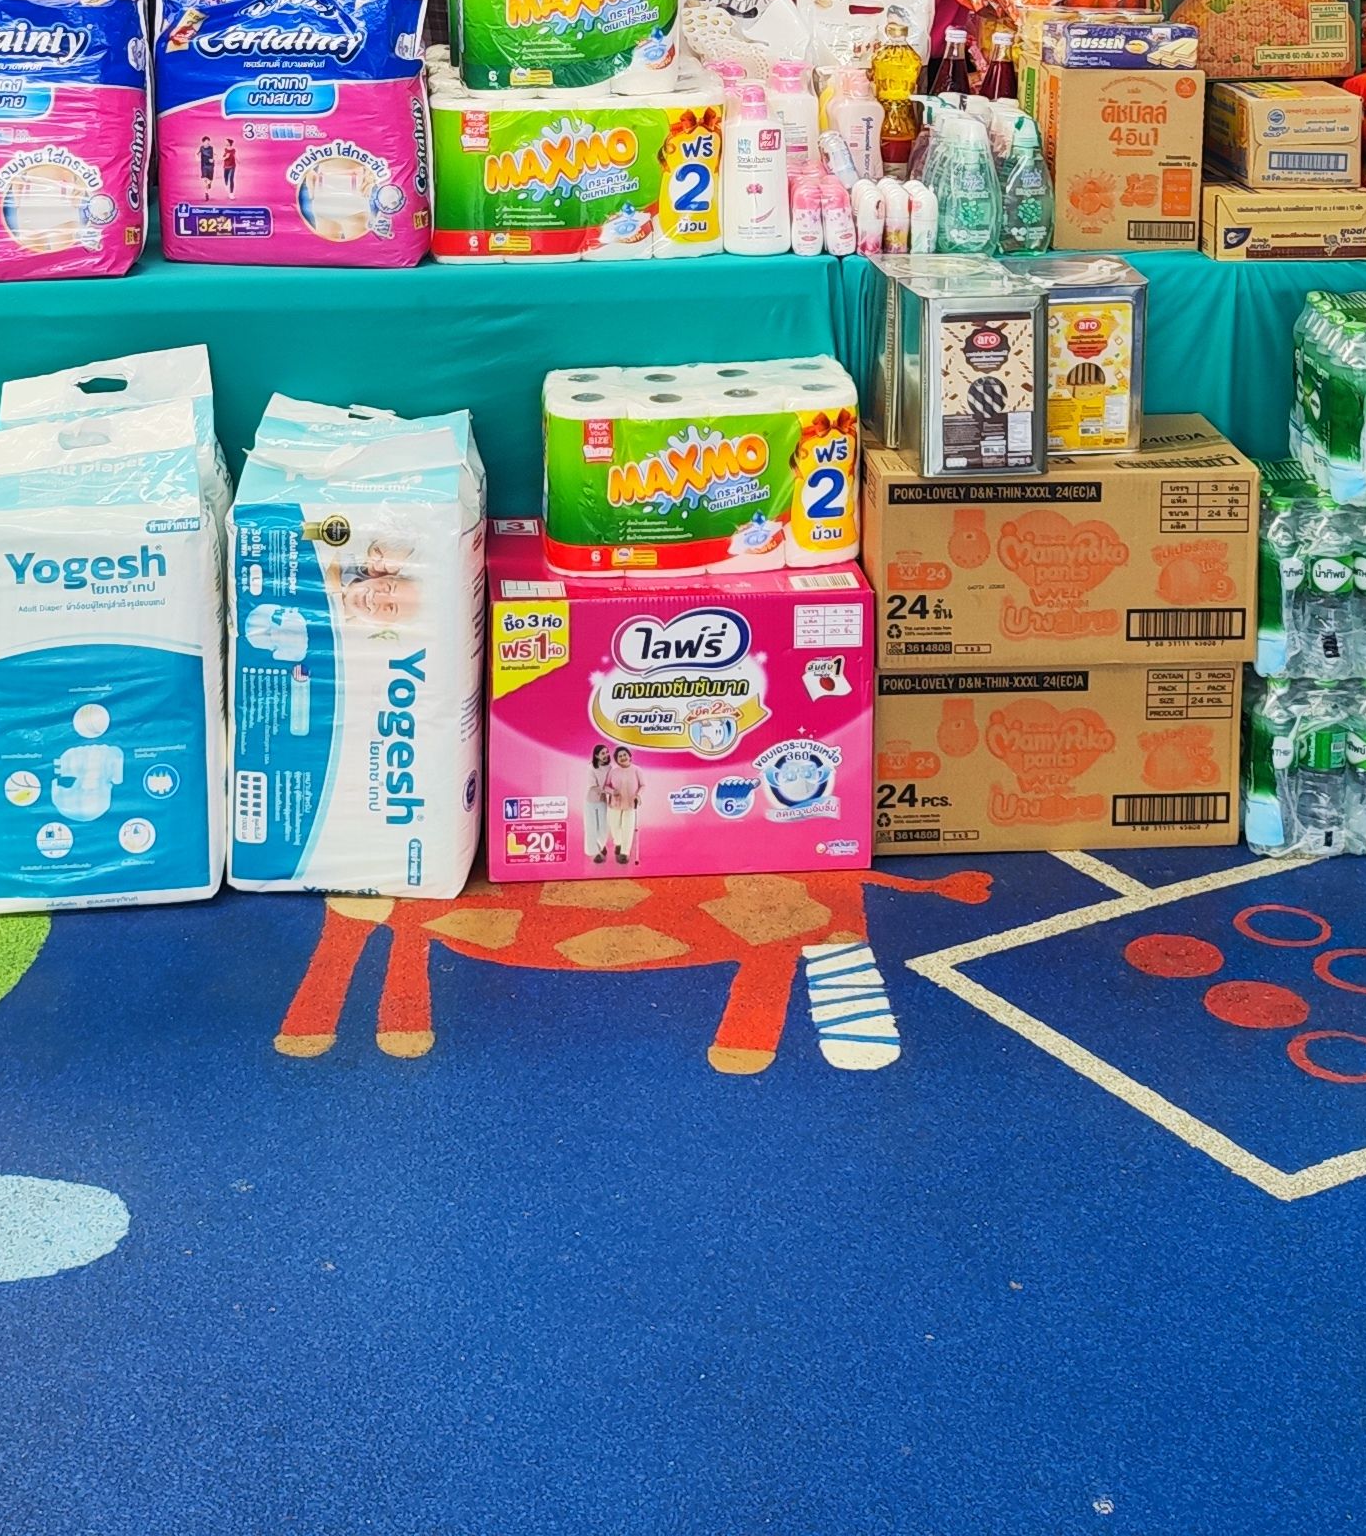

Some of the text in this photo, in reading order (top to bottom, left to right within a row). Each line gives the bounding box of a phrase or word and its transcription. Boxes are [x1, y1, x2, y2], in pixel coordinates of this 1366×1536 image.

[259, 76, 308, 91] กางเกง
[488, 70, 498, 82] 6
[248, 91, 313, 106] บางสบาย
[1101, 98, 1169, 125] ดัชมิลล์
[243, 124, 255, 139] 3
[682, 135, 714, 158] ฟรี
[289, 142, 388, 182] สวมง่าย ใส่กระชับ
[487, 129, 636, 191] MAXMO
[674, 163, 711, 212] 2
[179, 217, 193, 235] L
[468, 234, 479, 248] 6
[1078, 320, 1098, 331] aro
[976, 335, 997, 345] aro
[588, 422, 609, 431] PICK
[588, 437, 609, 445] SIZE
[815, 439, 848, 463] ฟรี
[609, 436, 767, 504] MAXMO
[715, 481, 758, 500] กระดาษ
[807, 468, 846, 519] 2
[894, 485, 1097, 500] POKO-LOVELY D&N-THIN-XXXL 24(EC)A
[811, 525, 843, 541] ม้วน
[591, 550, 601, 562] 6
[998, 530, 1129, 571] MamyPoko
[4, 544, 167, 590] Yogesh
[927, 567, 946, 581] 24
[1315, 564, 1347, 579] น้ำทิพย์
[132, 580, 156, 593] เทป
[40, 603, 63, 613] Diaper
[887, 594, 953, 620] 24 ชิ้น
[504, 614, 562, 631] ซื้อ 3 ห่อ
[502, 633, 563, 660] ฟรี 1 ห่อ
[634, 622, 728, 660] ไลฟ์รี่
[906, 643, 951, 653] 3614808
[833, 658, 842, 676] 1
[883, 675, 1084, 691] POKO-LOVELY D&N-THIN-XXXL 24(EC)A
[1152, 672, 1184, 680] CONTAIN
[613, 676, 749, 700] กางเกงซึมซับมาก
[1207, 684, 1226, 692] PACK
[712, 702, 724, 715] 2
[619, 711, 673, 725] สวมง่าย
[377, 647, 427, 826] Yogesh
[986, 719, 1116, 759] MamyPoko
[877, 783, 953, 810] 24 PCS.
[520, 804, 531, 817] 2
[723, 799, 734, 813] 6
[508, 832, 555, 854] L 20
